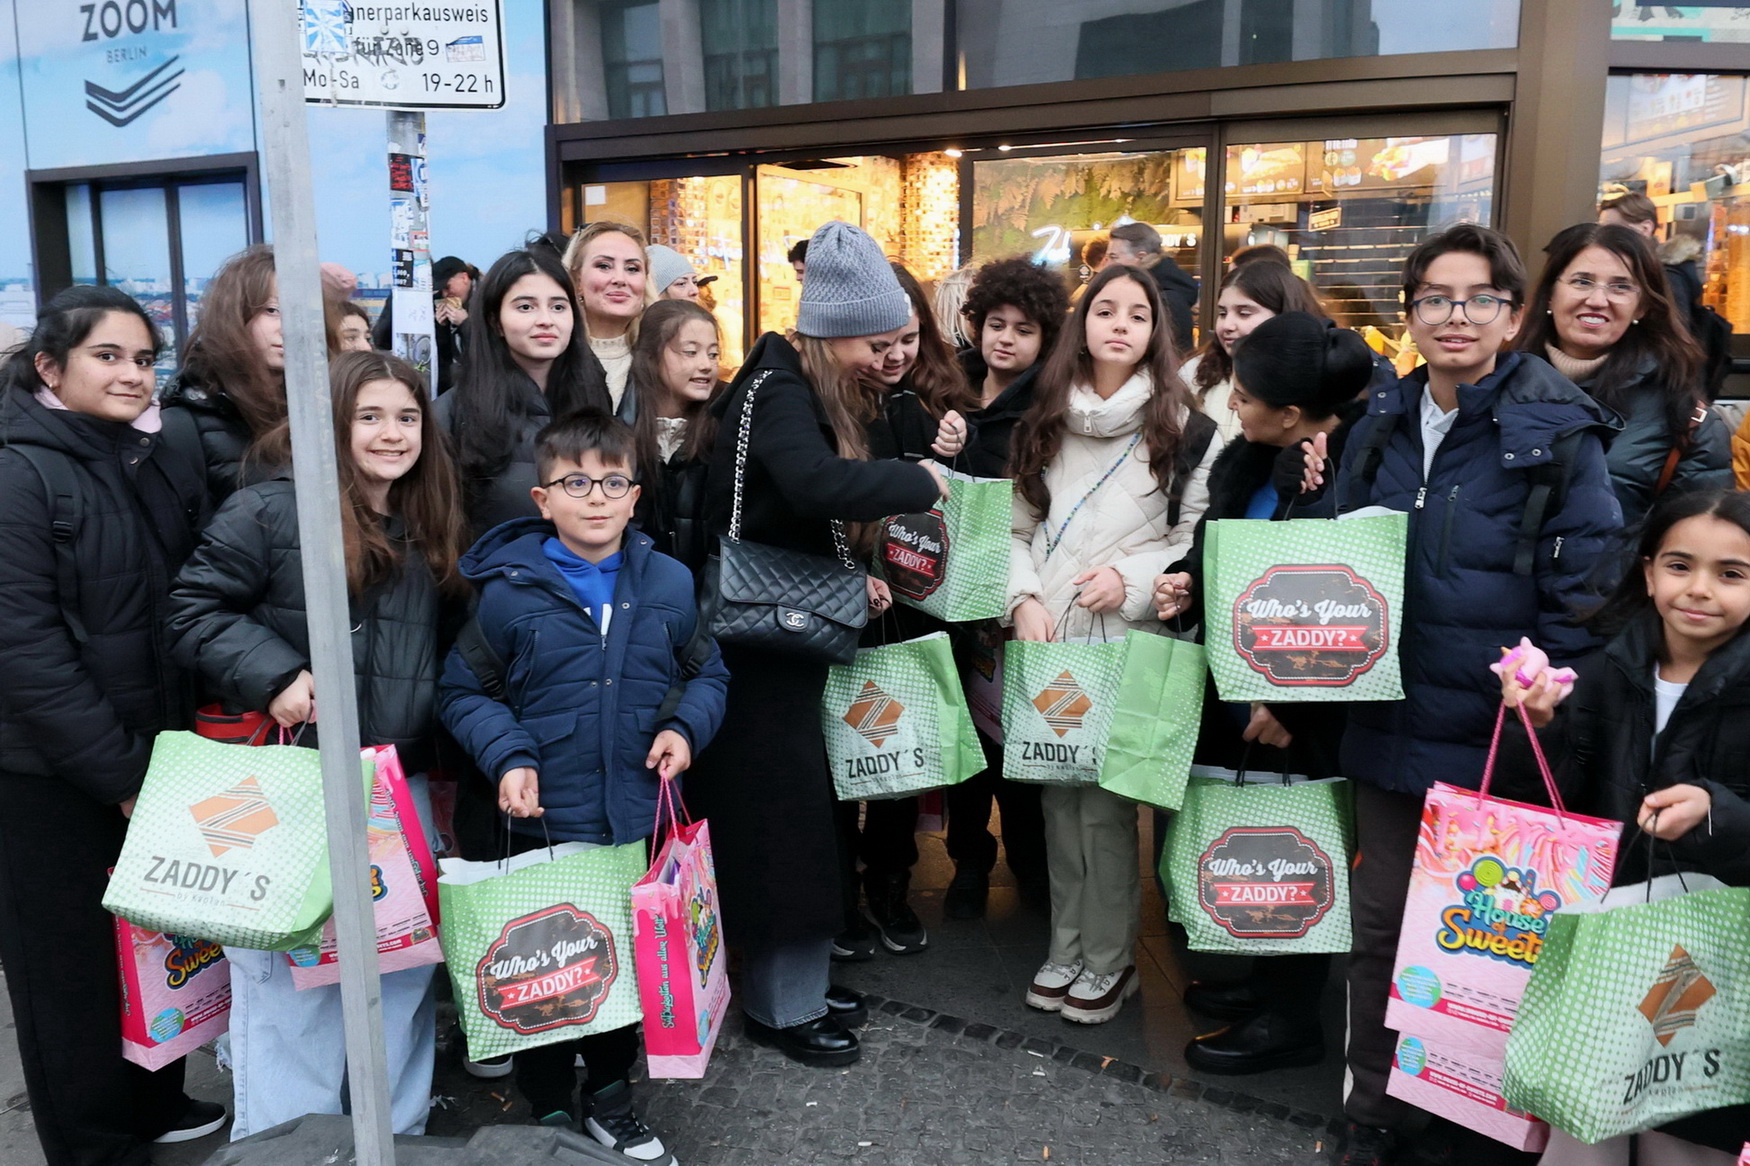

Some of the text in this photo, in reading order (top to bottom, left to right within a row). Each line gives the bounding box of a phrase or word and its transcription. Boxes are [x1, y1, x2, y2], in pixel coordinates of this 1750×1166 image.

[80, 0, 178, 41] ZOOM
[356, 2, 489, 26] nerparkausweis
[106, 46, 148, 63] BERLIN
[427, 39, 440, 56] 9
[422, 73, 478, 93] 19-22
[484, 74, 494, 93] h
[888, 523, 942, 553] Who's Your
[892, 548, 929, 571] ZADDY?
[1246, 599, 1373, 626] Who's Your
[1270, 630, 1348, 647] ZADDY?
[1208, 858, 1319, 883] Who's Your
[1229, 886, 1299, 902] ZADDY?
[1465, 890, 1545, 934] House
[1437, 907, 1544, 964] Sweet
[165, 943, 222, 987] Swee
[489, 935, 599, 980] Who's Your
[517, 966, 584, 1002] ZADDY?
